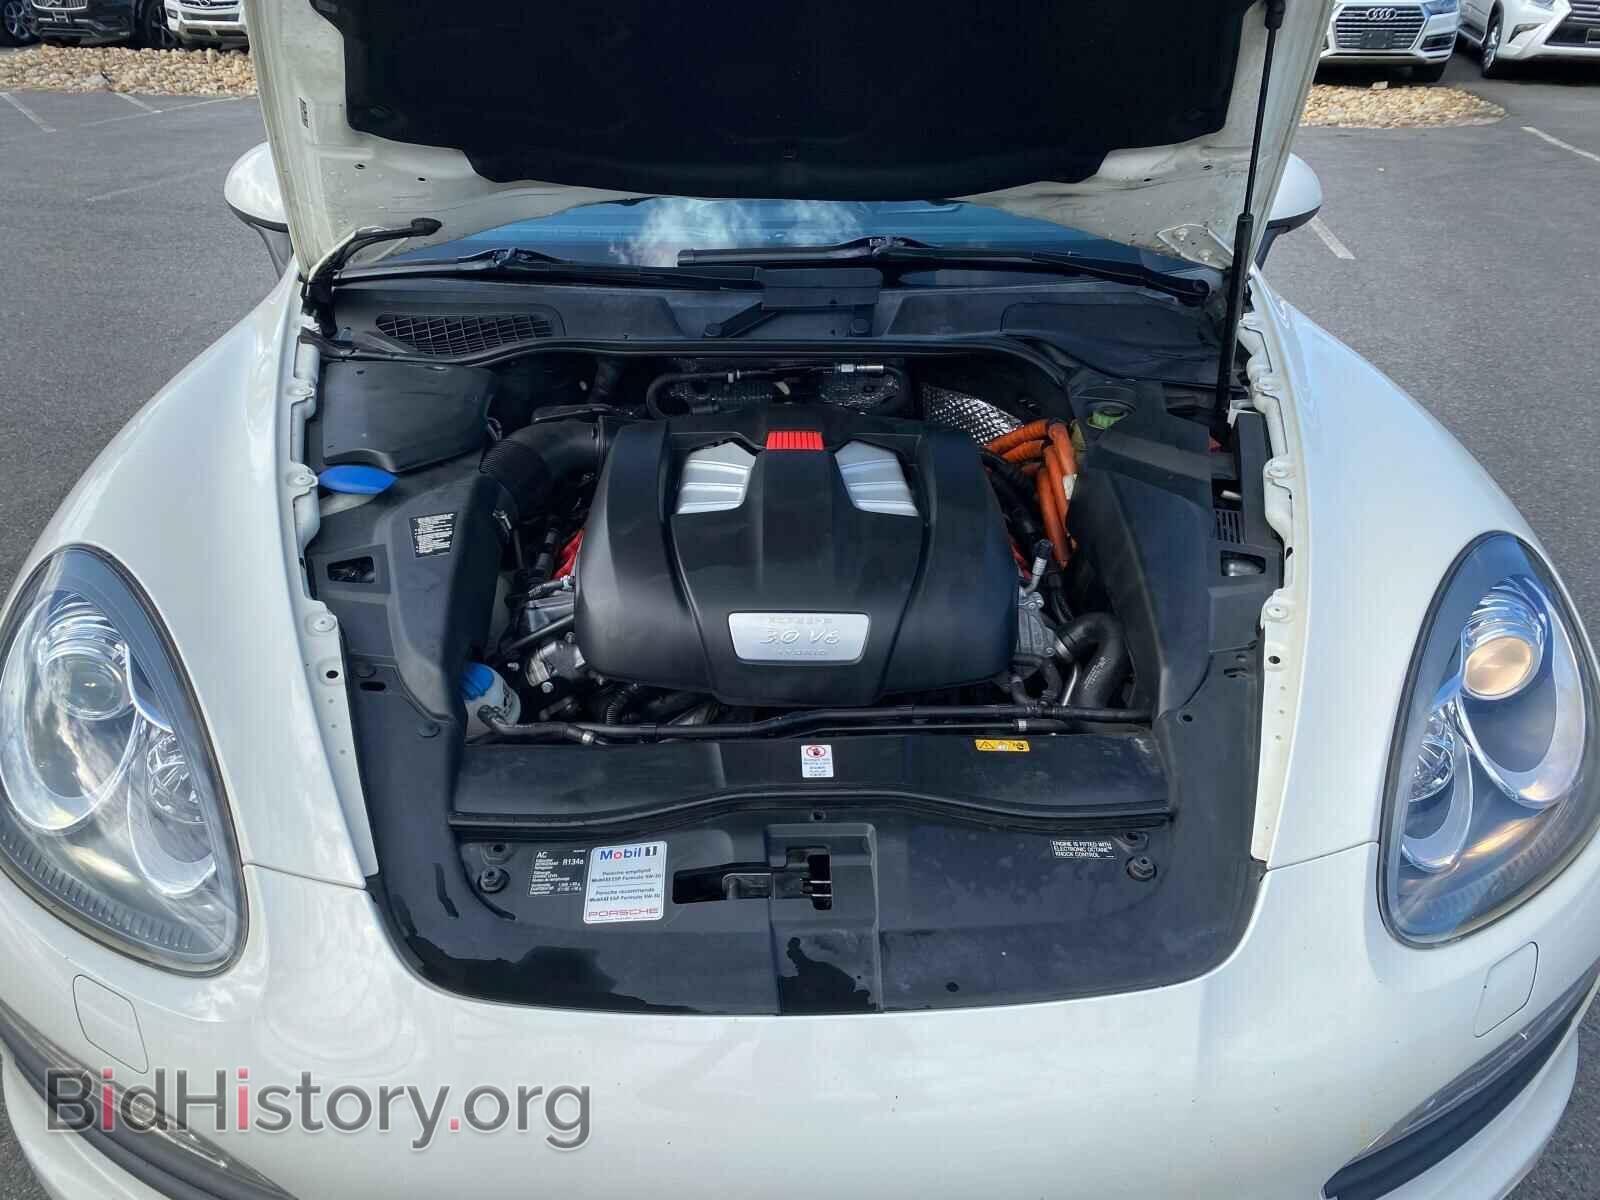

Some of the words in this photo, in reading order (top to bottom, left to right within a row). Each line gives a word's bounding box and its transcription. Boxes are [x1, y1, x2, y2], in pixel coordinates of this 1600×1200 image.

[808, 629, 841, 645] V6
[536, 851, 548, 859] AC
[600, 847, 642, 861] Mobil
[562, 858, 584, 866] R134a
[588, 907, 659, 917] PORSCHE
